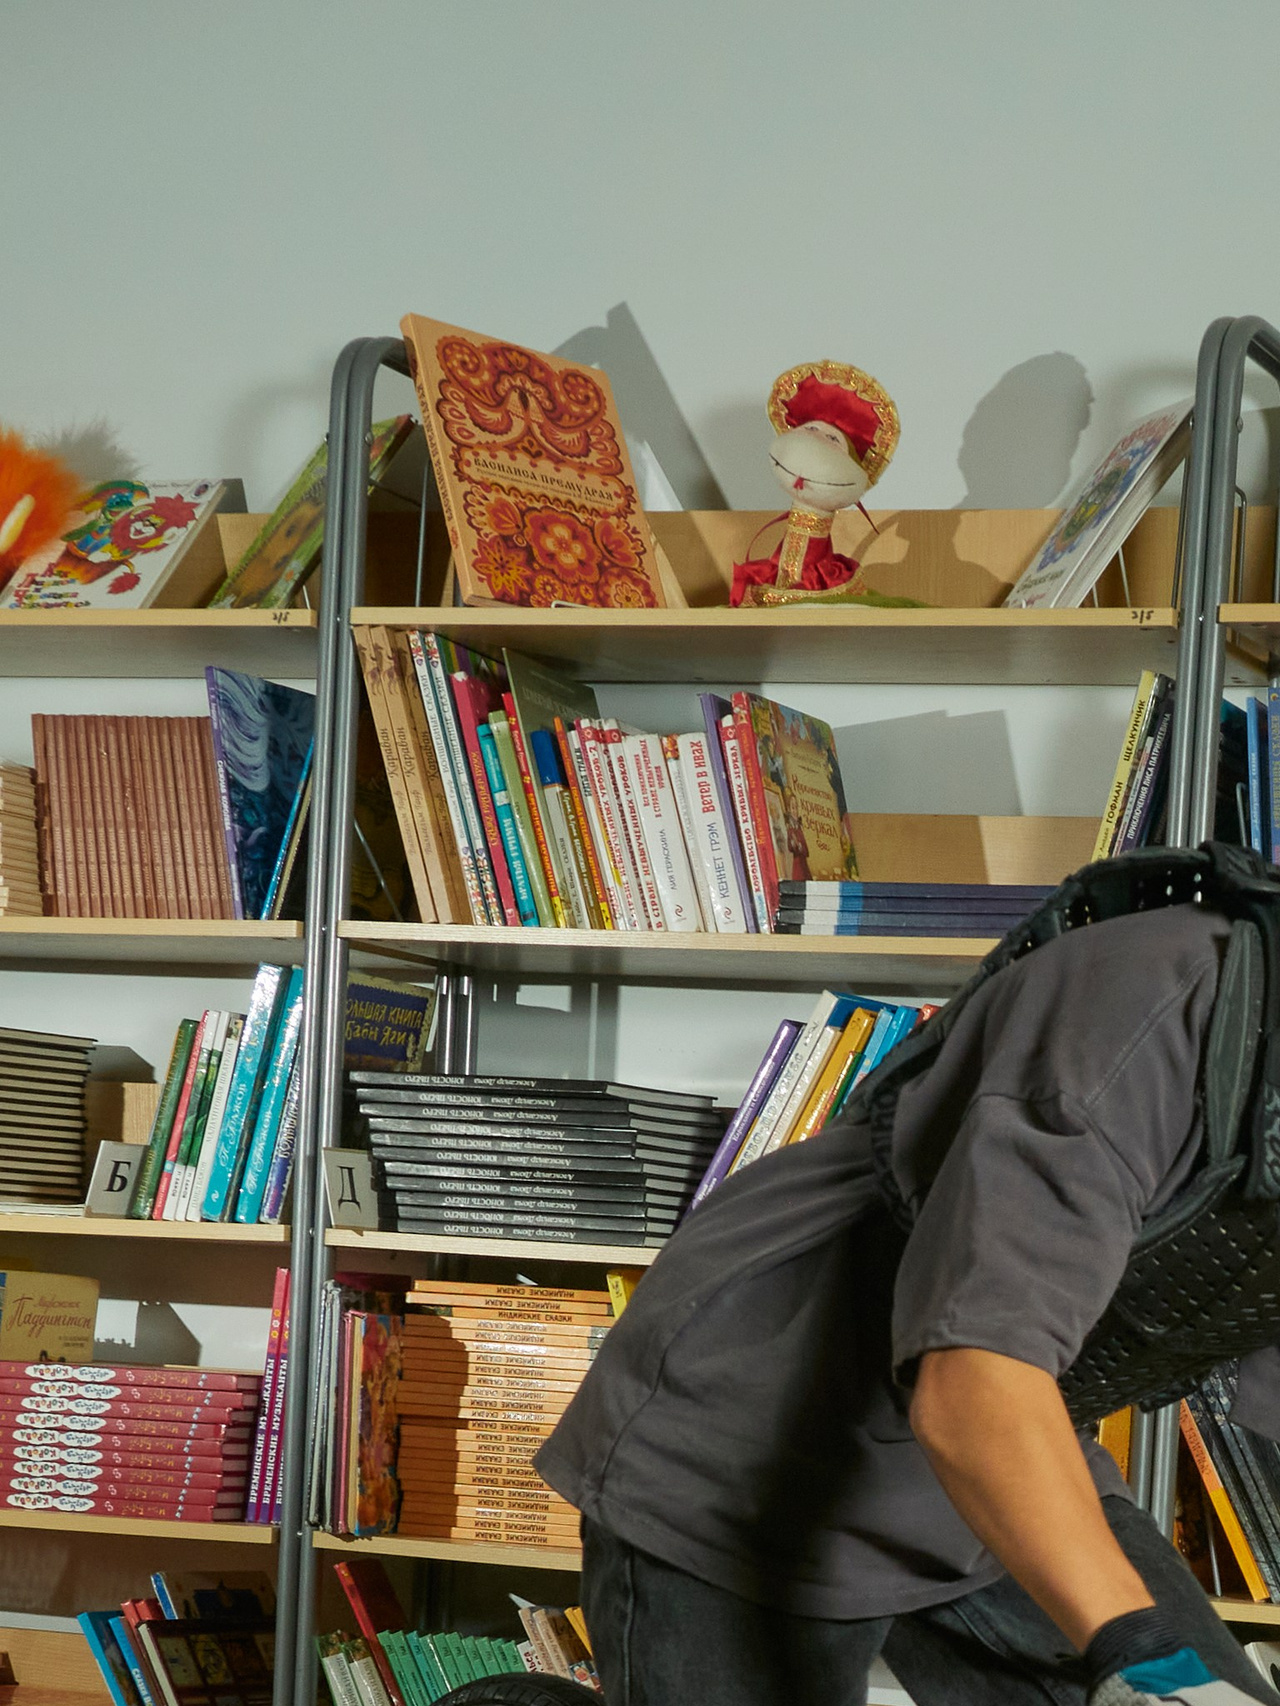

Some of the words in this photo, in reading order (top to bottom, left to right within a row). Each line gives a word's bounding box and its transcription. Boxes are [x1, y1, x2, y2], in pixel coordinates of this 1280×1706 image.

[1102, 780, 1125, 825] ГОФМАН
[1120, 698, 1149, 763] ЩЕЛКУНЧИК
[1146, 710, 1174, 767] ПАТРИКЕЕВИЧА
[729, 745, 742, 780] ЗЕРКАЛ
[1142, 765, 1155, 786] ЛИСА
[735, 782, 749, 824] КРИВЫХ
[1124, 785, 1150, 840] ПРИКЛЮЧЕНИЯ
[657, 827, 673, 873] ГЕРАСКИНА
[706, 821, 721, 851] ГРЭМ
[667, 873, 676, 890] ЛИЯ
[711, 854, 730, 899] КЕННЕТ
[743, 827, 762, 893] КОРОЛЕВСТВО
[103, 1160, 132, 1192] Б
[337, 1165, 361, 1211] Д
[268, 1358, 290, 1431] МУЗЫКАНТЫ
[258, 1433, 281, 1505] БРЕМЕНСКИЕ
